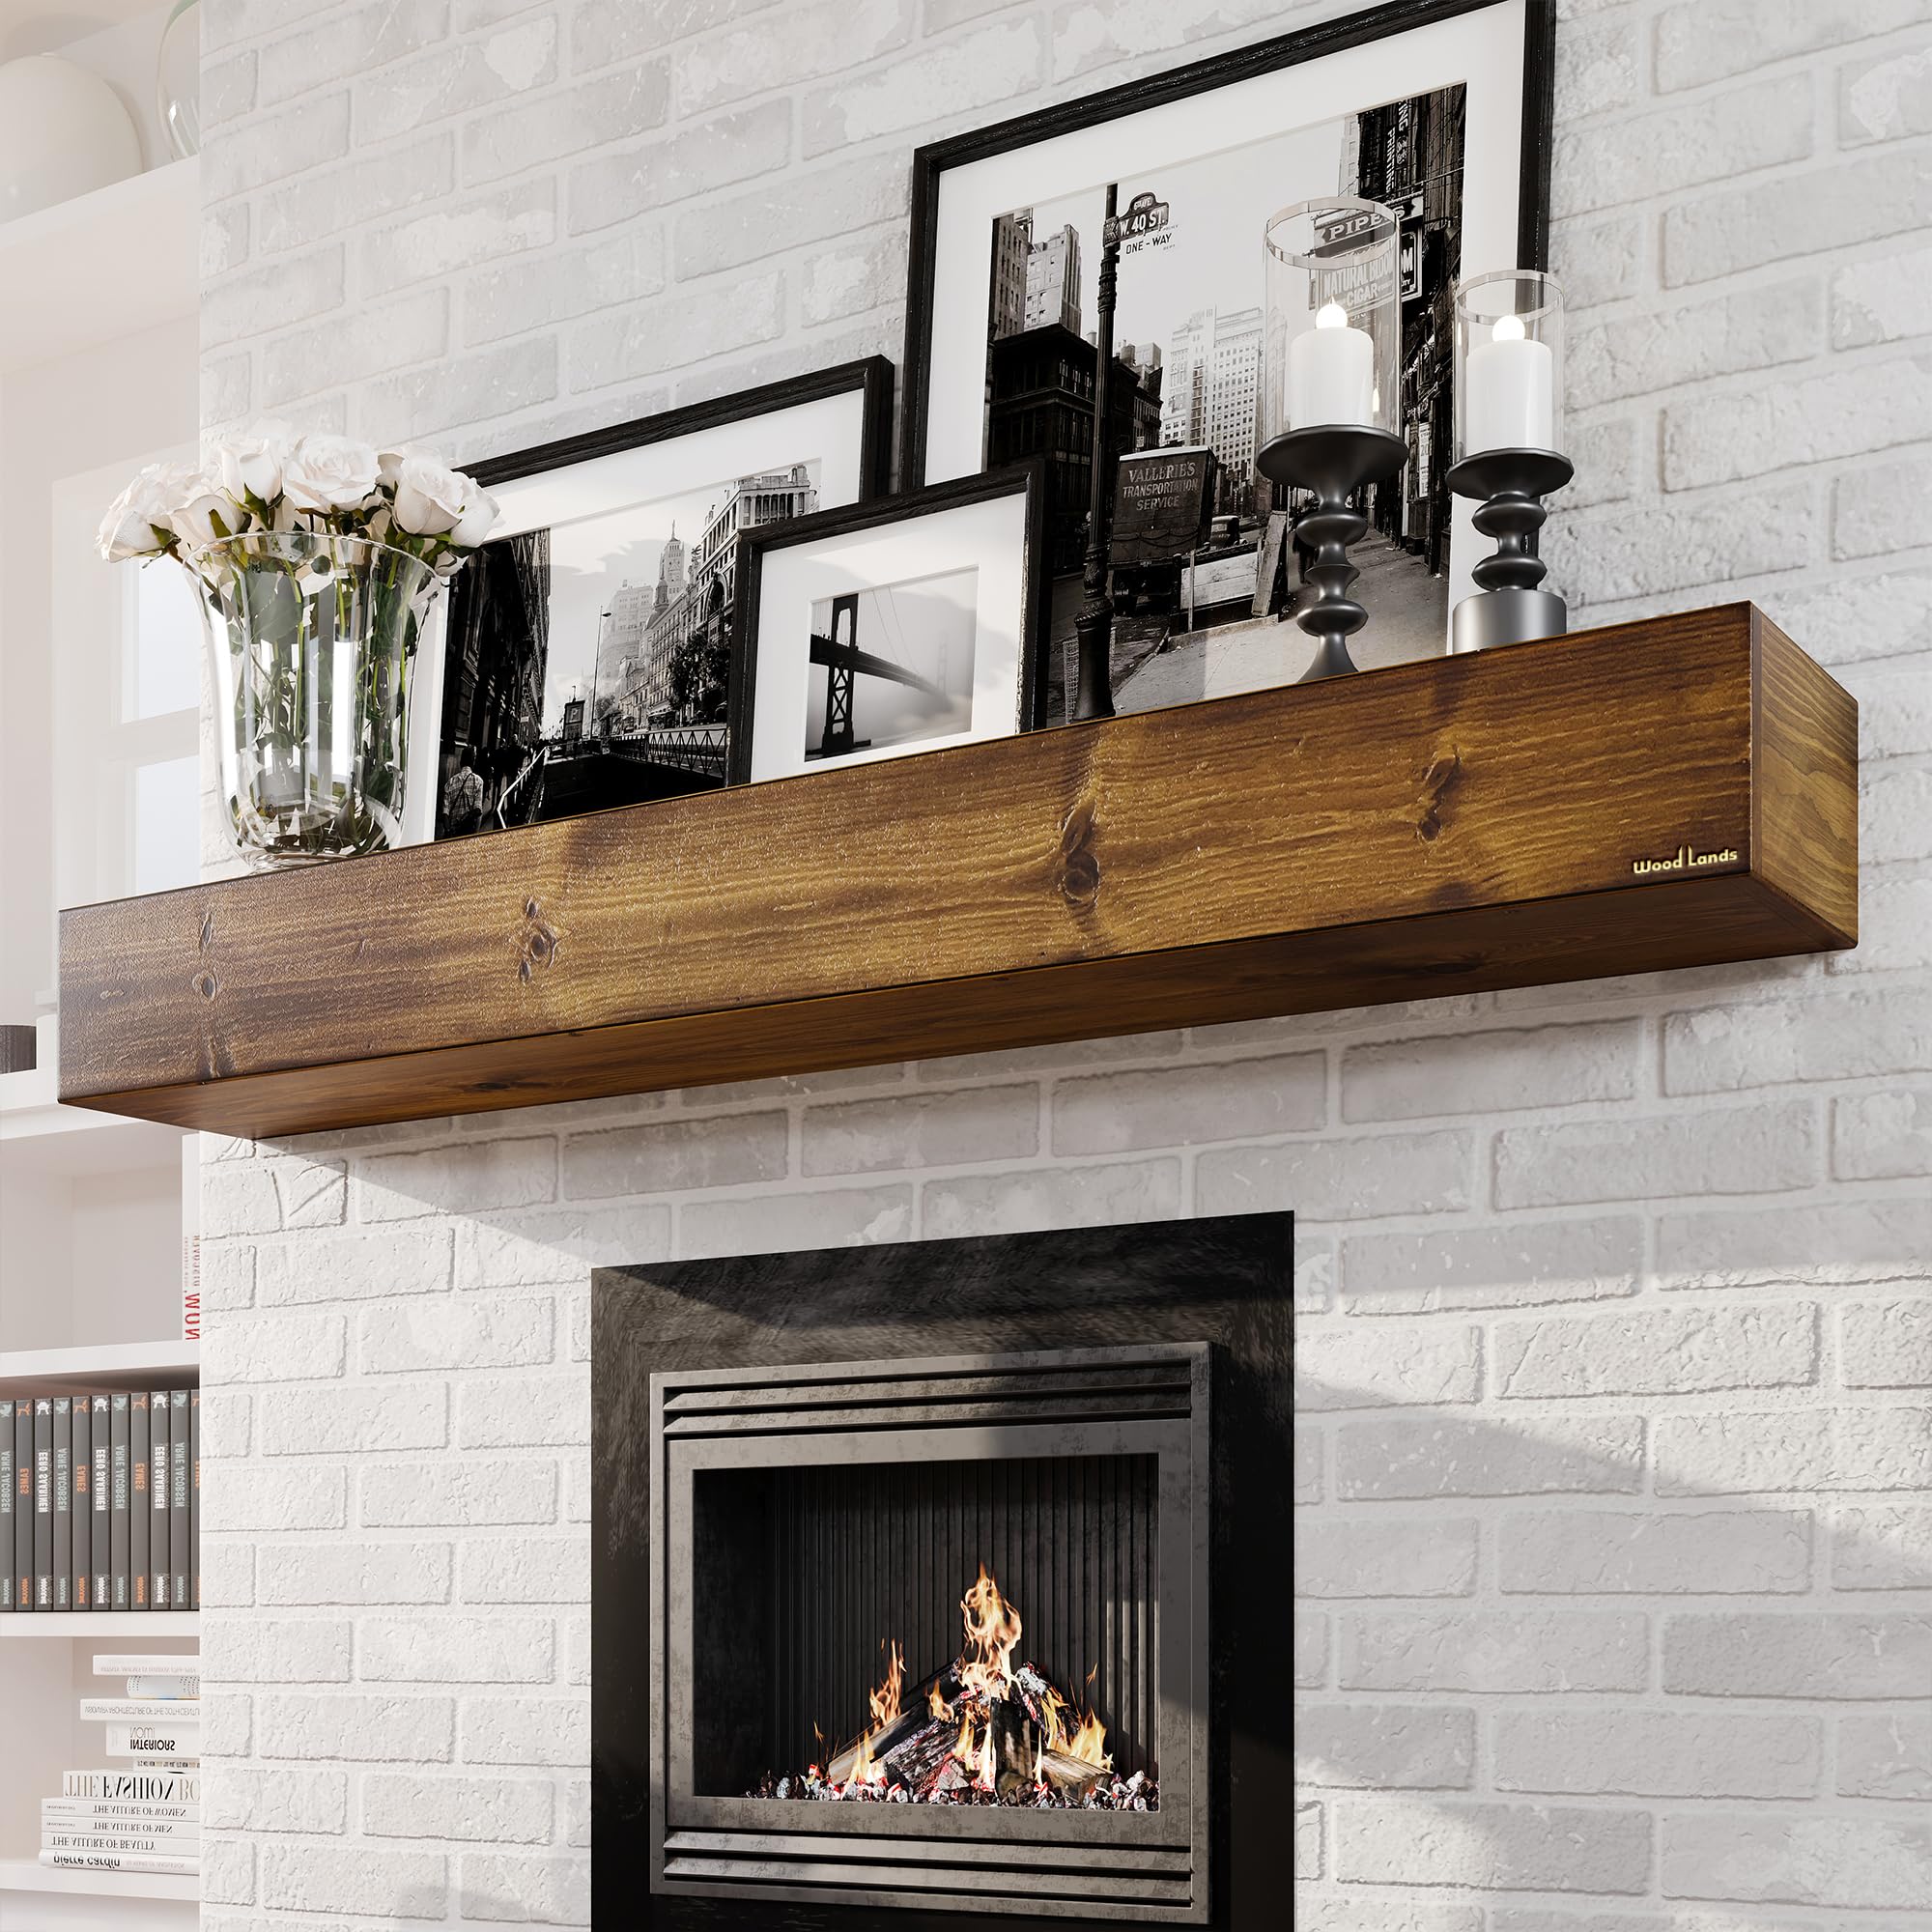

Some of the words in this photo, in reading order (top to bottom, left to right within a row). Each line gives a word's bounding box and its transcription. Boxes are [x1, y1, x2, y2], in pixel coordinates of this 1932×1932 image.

[1385, 127, 1396, 193] PRINTING
[1121, 218, 1130, 237] W.
[1131, 213, 1147, 233] 40
[1346, 283, 1378, 307] CIGAR
[1128, 462, 1196, 483] VALLERIE'S
[1122, 478, 1199, 499] TRANSPORTATION
[1136, 496, 1179, 511] SERVICE
